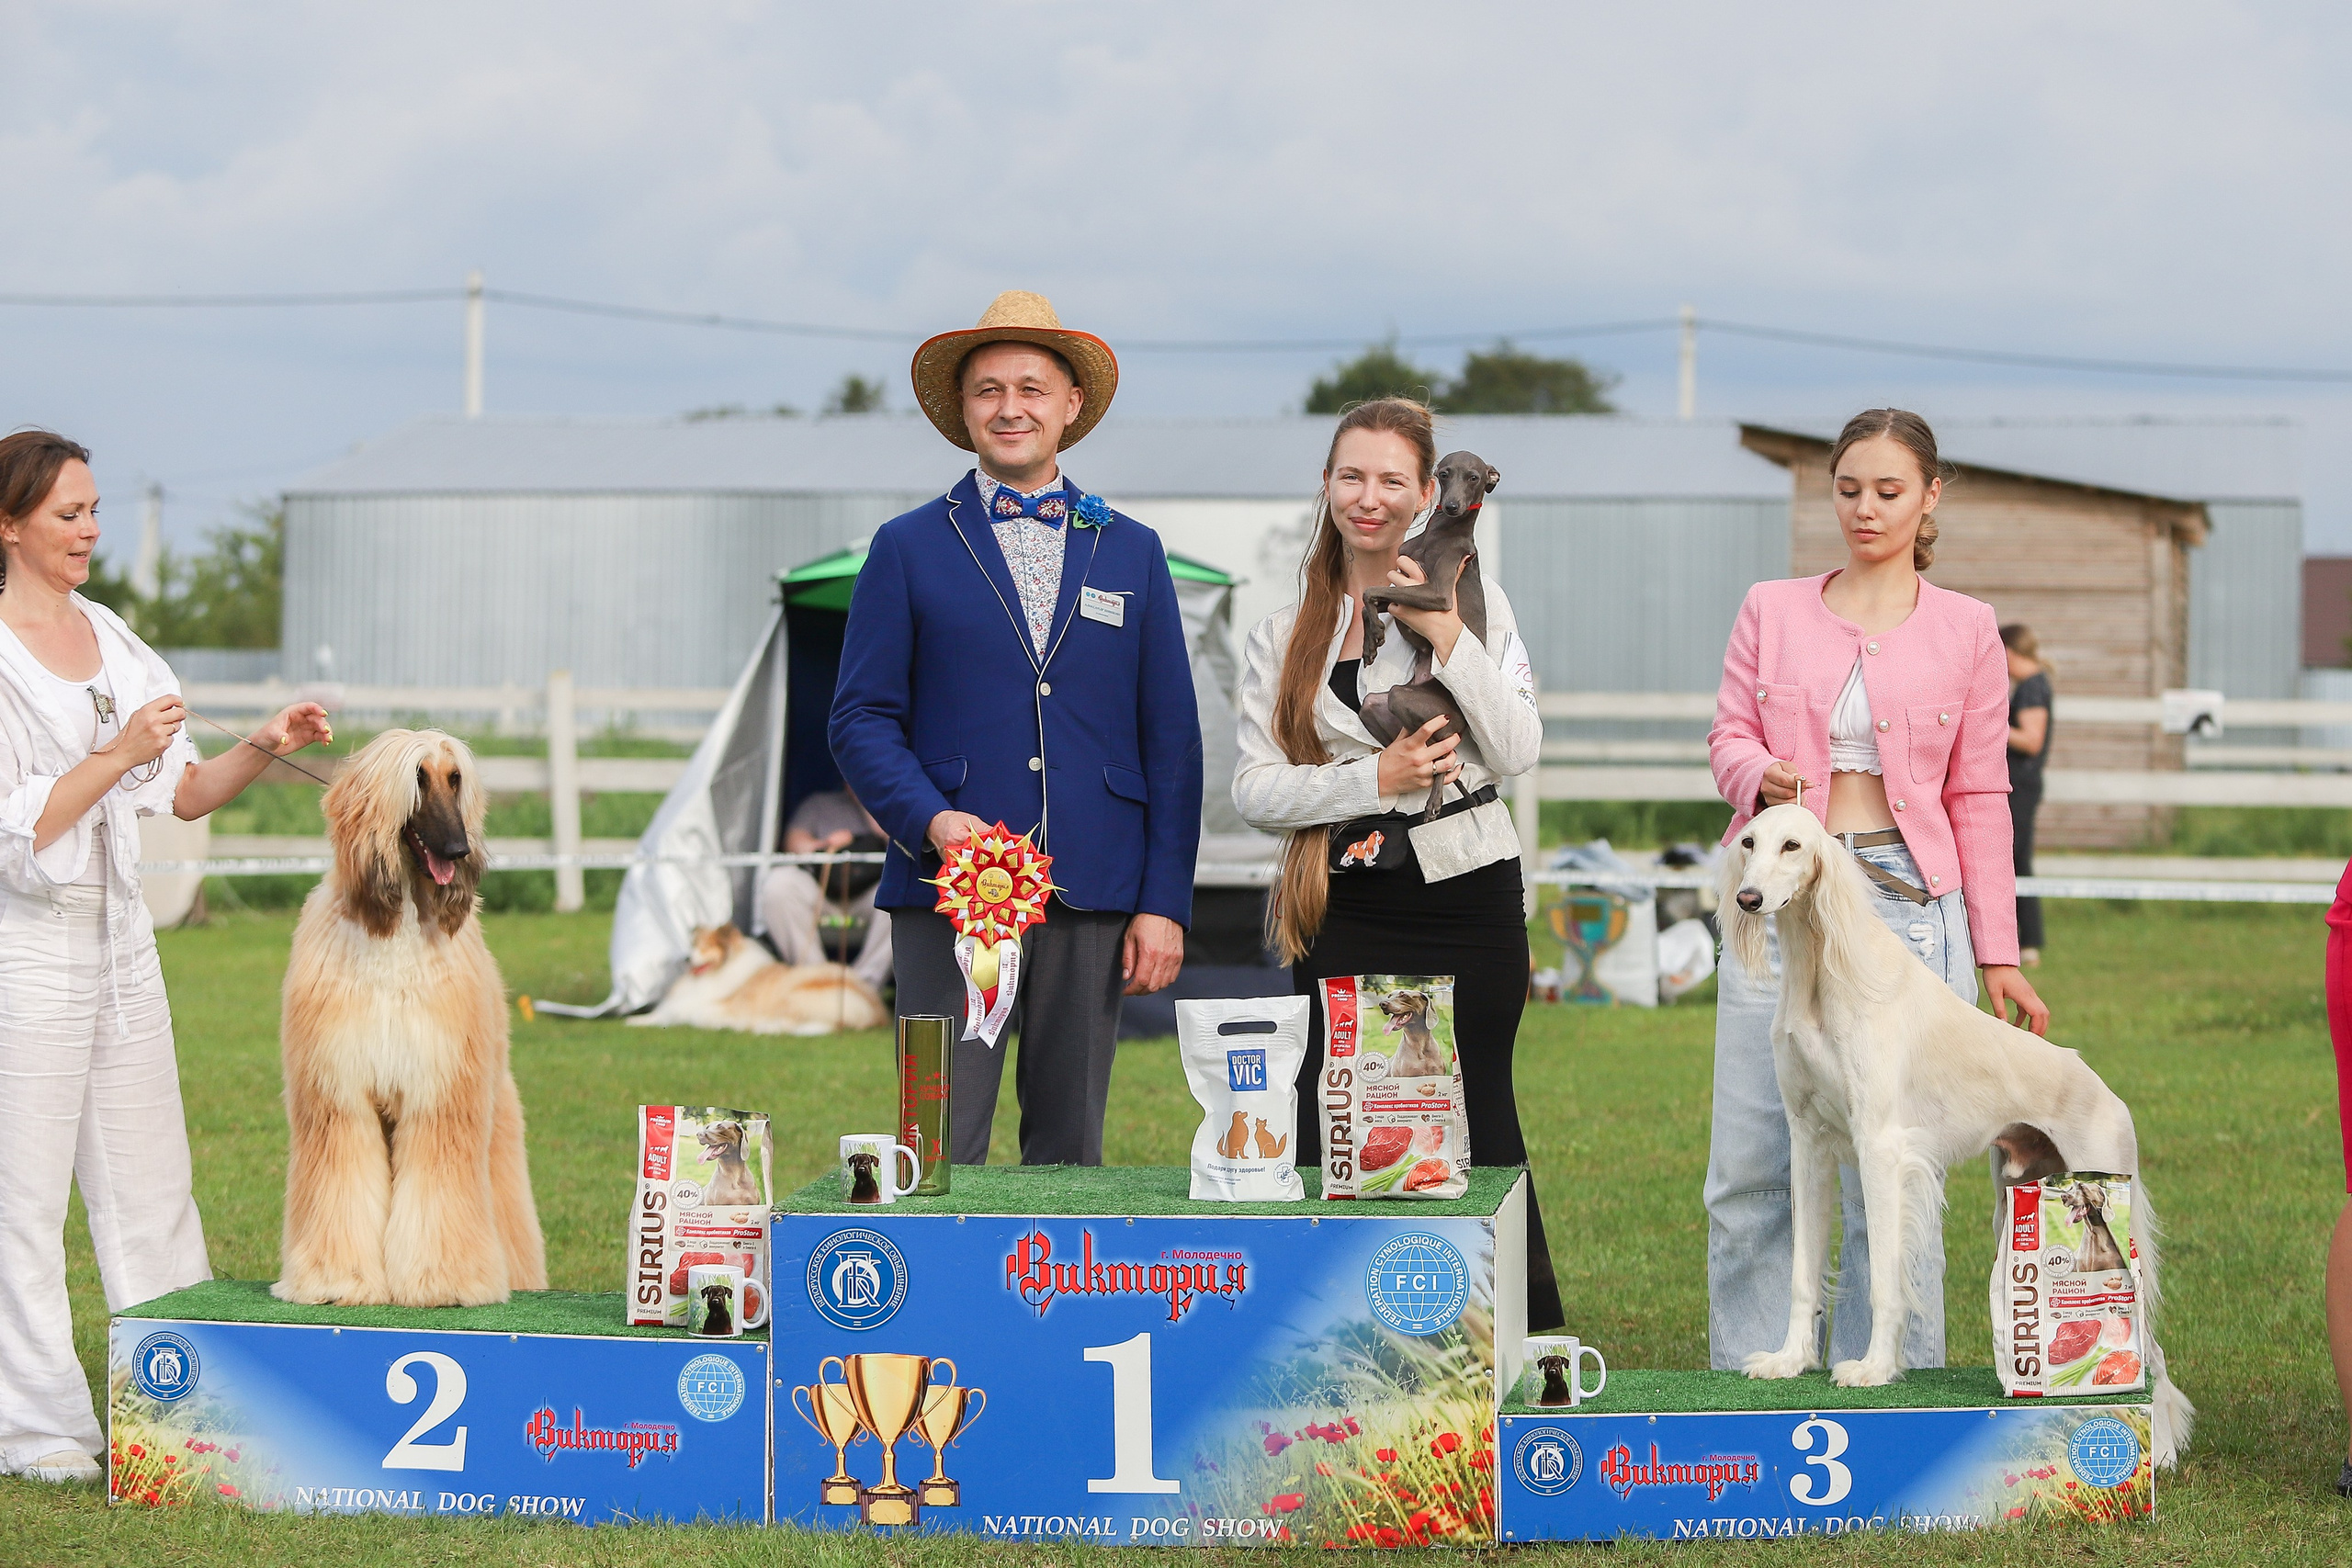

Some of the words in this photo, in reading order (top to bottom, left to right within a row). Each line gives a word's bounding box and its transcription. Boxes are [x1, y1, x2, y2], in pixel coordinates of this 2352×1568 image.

[1333, 1031, 1351, 1040] ADULT
[1232, 1055, 1261, 1064] DOCTOR
[1363, 1062, 1384, 1071] 40%
[1232, 1064, 1262, 1086] VIC
[1366, 1083, 1400, 1091] МЯСНОЙ
[1366, 1091, 1398, 1100] РАЦИОН
[1327, 1068, 1353, 1181] SIRIUS
[648, 1154, 667, 1164] ADULT
[677, 1190, 698, 1199] 40%
[2015, 1224, 2034, 1233] ADULT
[638, 1191, 667, 1304] SIRIUS
[1160, 1251, 1169, 1259] г.
[1172, 1249, 1242, 1260] Молодечно
[1374, 1236, 1443, 1266] CYNOLOGIQUE
[820, 1232, 891, 1254] КИНОЛОГИЧЕСКОЕ
[888, 1249, 905, 1309] ОБЪЕДИНЕНИЕ
[1006, 1225, 1249, 1323] Виктория
[2048, 1256, 2070, 1266] 40%
[1396, 1275, 1437, 1291] FCI
[1433, 1247, 1465, 1326] INTERNATIONALE
[1370, 1268, 1402, 1326] FEDERATION
[2012, 1263, 2041, 1377] SIRIUS
[684, 1357, 729, 1375] CYNOLOGIQUE
[681, 1377, 702, 1416] FEDERATION
[697, 1382, 725, 1393] FCI
[721, 1364, 742, 1416] INTERNATIONALE
[382, 1351, 469, 1472] 2
[1083, 1332, 1181, 1494] 1
[527, 1404, 679, 1469] Виктория
[2075, 1420, 2120, 1441] CYNOLOGIQUE
[1790, 1419, 1852, 1506] 3
[2072, 1442, 2094, 1482] FEDERATION
[2089, 1447, 2117, 1458] FCI
[2114, 1427, 2135, 1481] INTERNATIONALE
[1600, 1438, 1759, 1502] Виктория
[294, 1486, 425, 1510] NATIONAL
[436, 1492, 495, 1513] DOG
[508, 1495, 588, 1517] SHOW
[982, 1516, 1117, 1537] NATIONAL
[1130, 1517, 1190, 1538] DOG
[1202, 1518, 1283, 1539] SHOW
[1672, 1517, 1811, 1538] NATIONAL
[1825, 1516, 1884, 1535] DOG
[1900, 1515, 1981, 1533] SHOW
